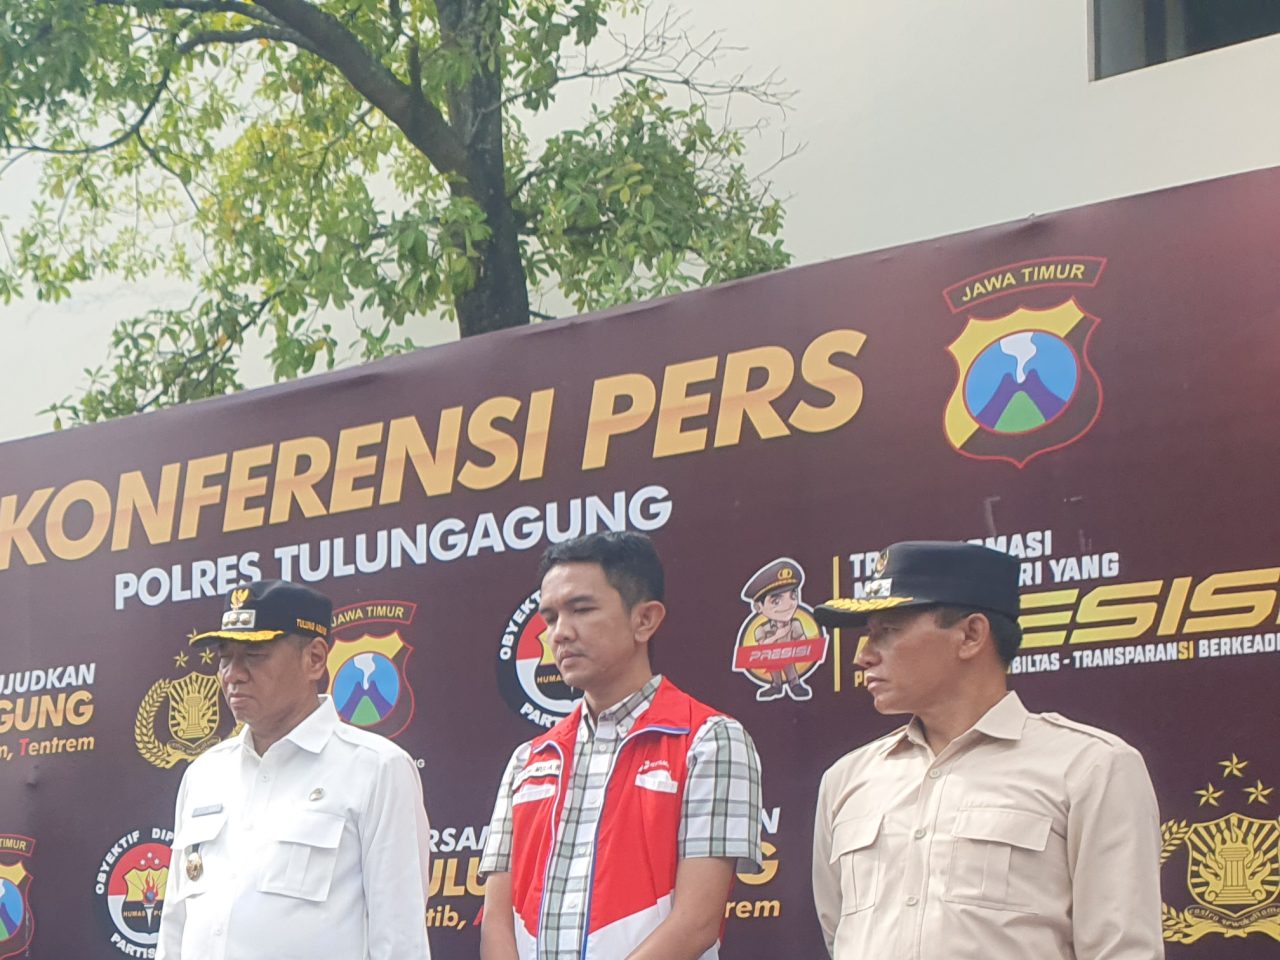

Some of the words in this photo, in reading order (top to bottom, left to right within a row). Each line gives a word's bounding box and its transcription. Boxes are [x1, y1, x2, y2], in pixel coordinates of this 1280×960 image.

[961, 272, 1016, 302] JAWA
[1020, 262, 1085, 284] TIMUR
[581, 329, 867, 471] PERS
[115, 551, 261, 609] POLRES
[274, 485, 672, 584] TULUNGAGUNG
[1049, 552, 1119, 583] YANG
[331, 610, 363, 627] JAWA
[366, 606, 404, 618] TIMUR
[1074, 641, 1194, 669] TRANSPARANSI
[19, 736, 95, 756] Tentrem
[95, 829, 140, 895] OBYEKTIF
[110, 932, 156, 959] PARTIS
